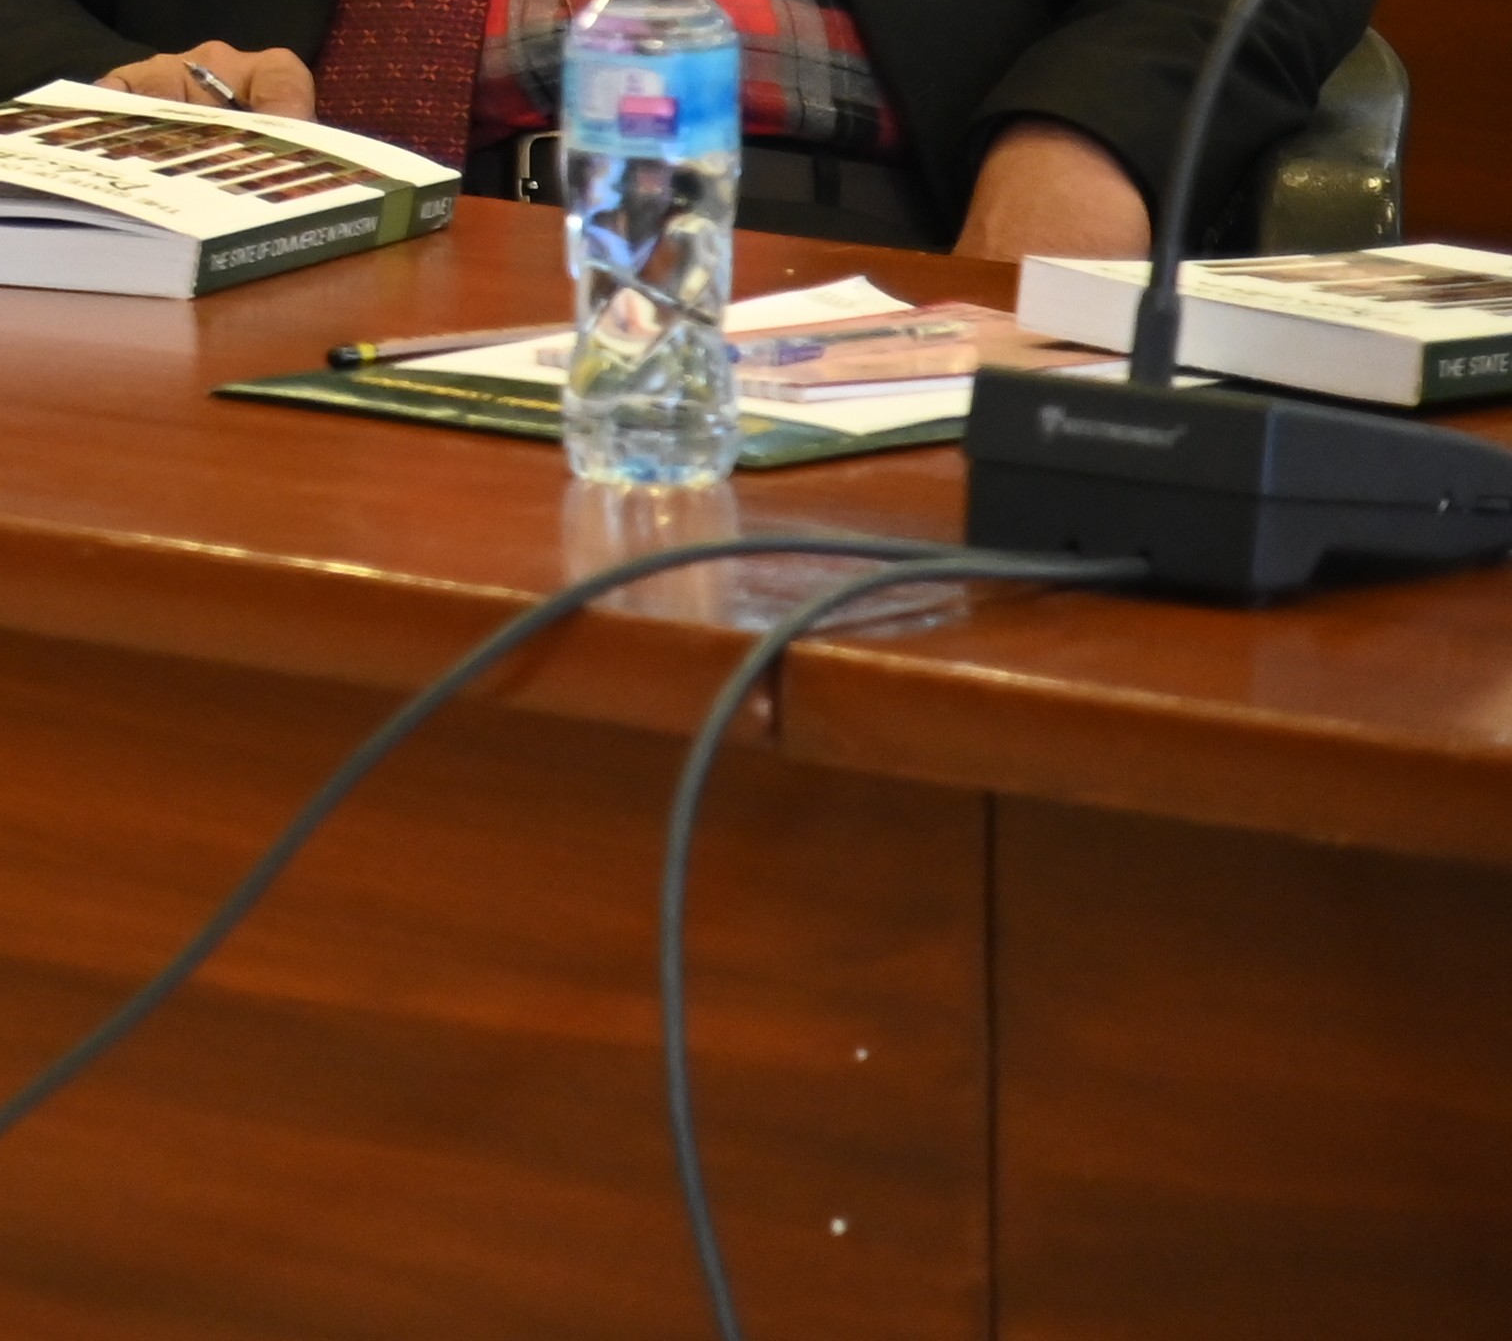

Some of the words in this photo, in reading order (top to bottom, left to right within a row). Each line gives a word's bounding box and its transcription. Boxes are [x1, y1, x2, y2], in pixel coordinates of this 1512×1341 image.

[271, 228, 327, 258] COMMERCE
[1439, 356, 1466, 378] THE
[1469, 352, 1511, 376] STATE
